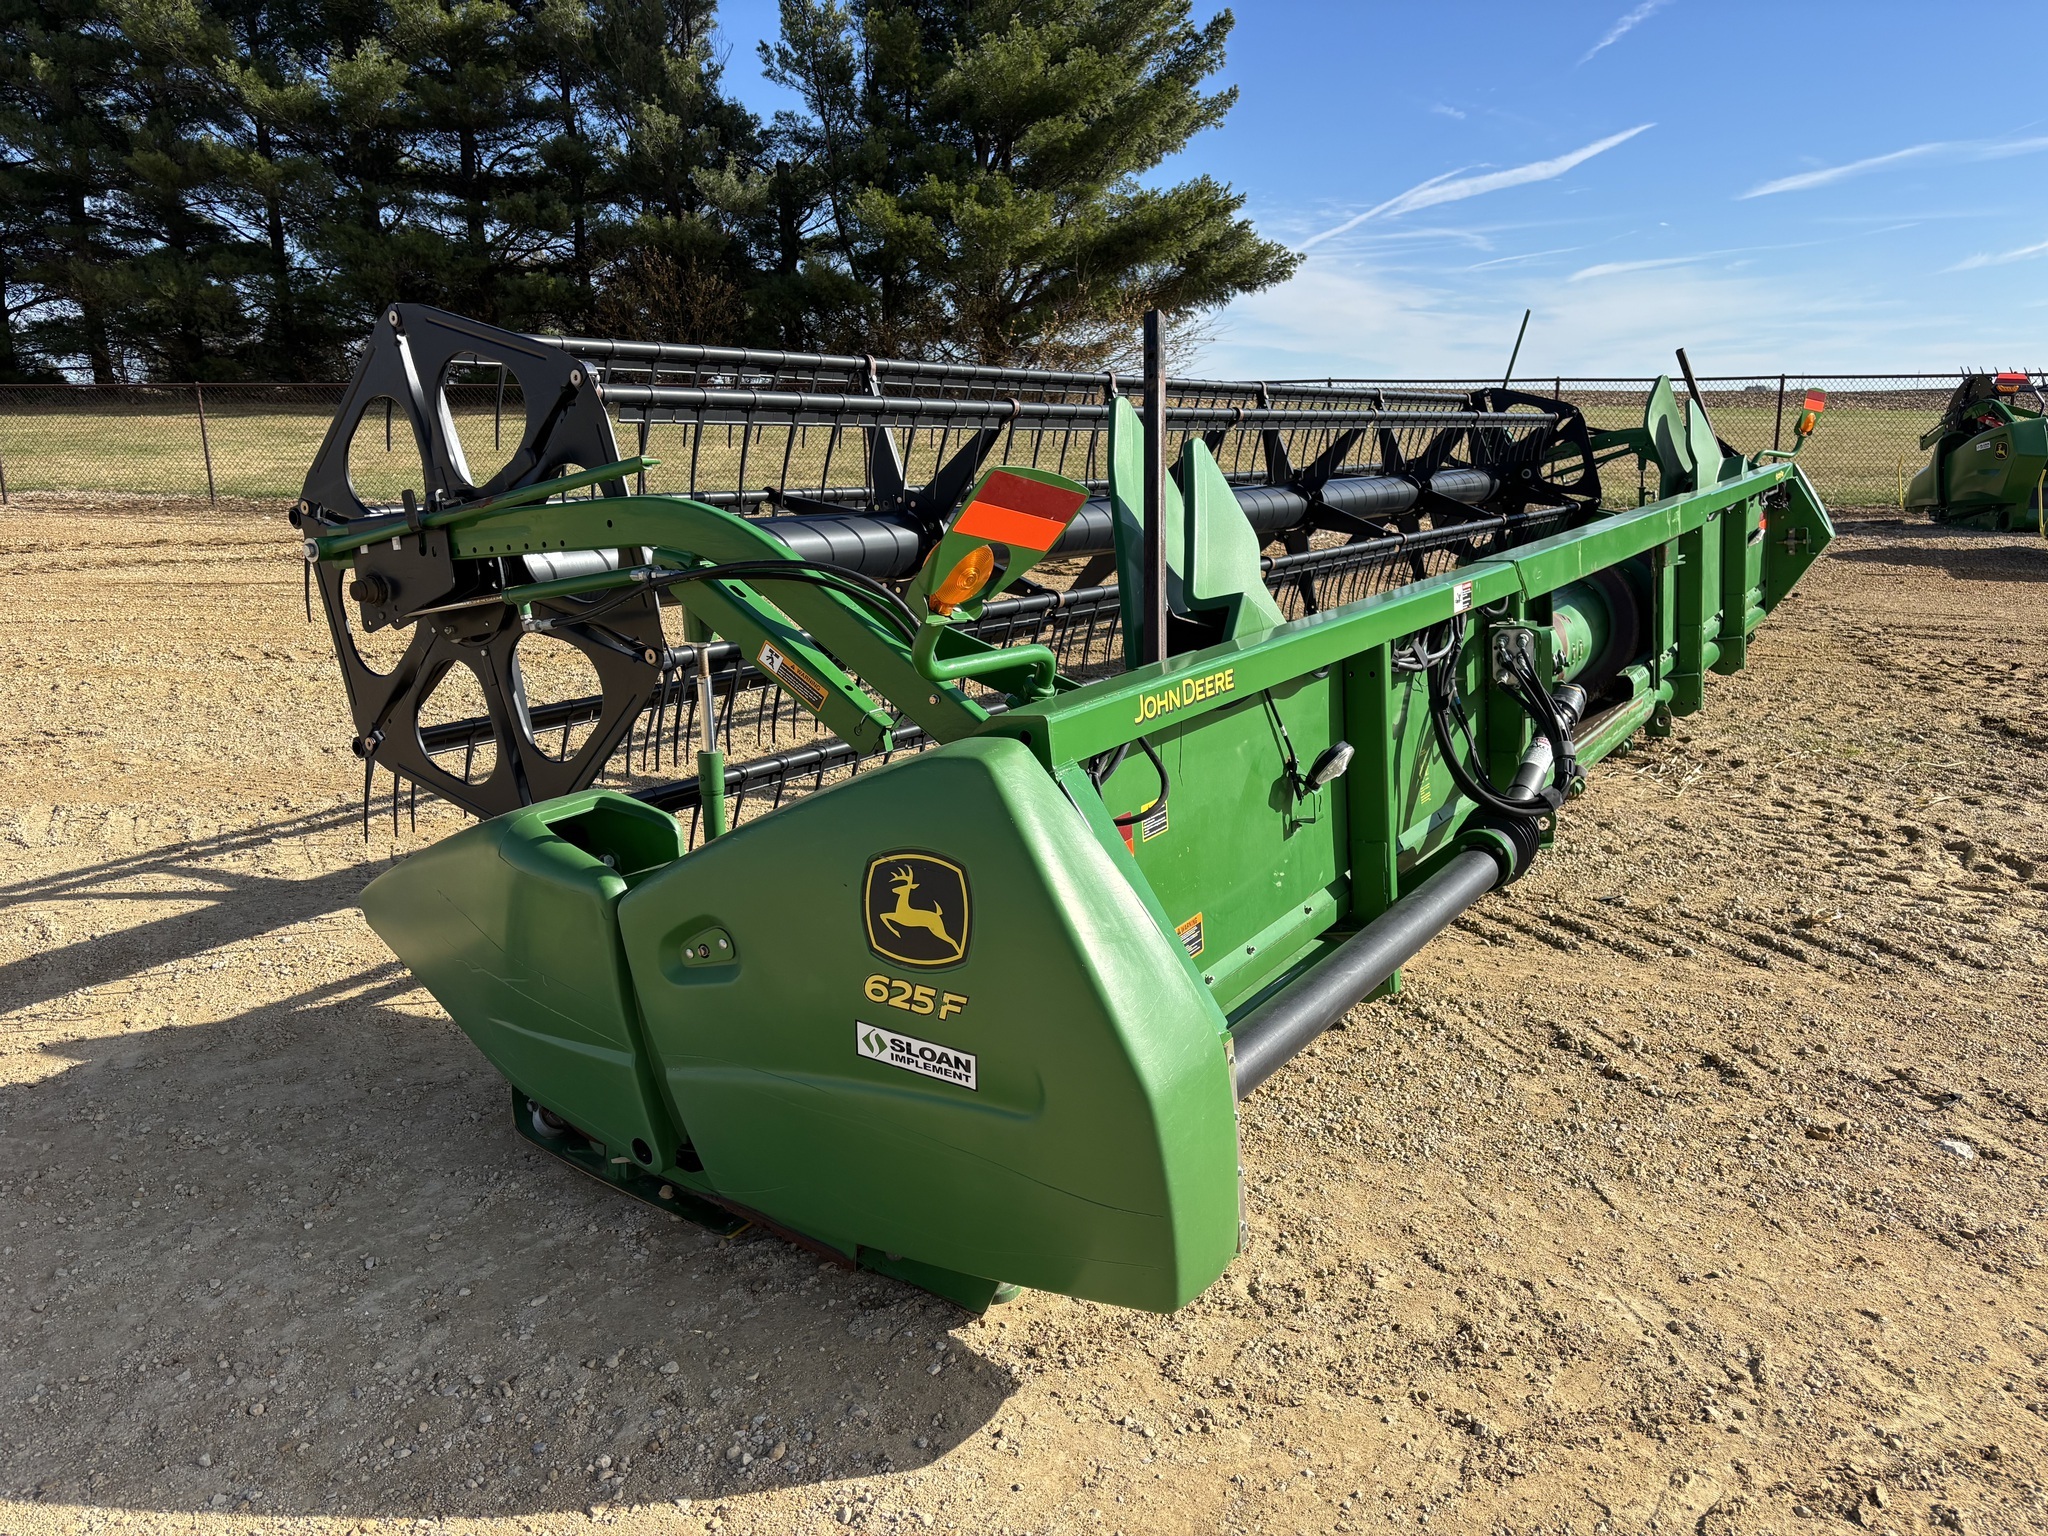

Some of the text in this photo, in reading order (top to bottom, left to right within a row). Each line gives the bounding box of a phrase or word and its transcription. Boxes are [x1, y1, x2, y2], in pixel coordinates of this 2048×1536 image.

[1134, 668, 1235, 724] JOHN DEERE
[863, 973, 969, 1021] 625F
[889, 1038, 972, 1074] SLOAN
[890, 1052, 972, 1083] IMPLEMENT
